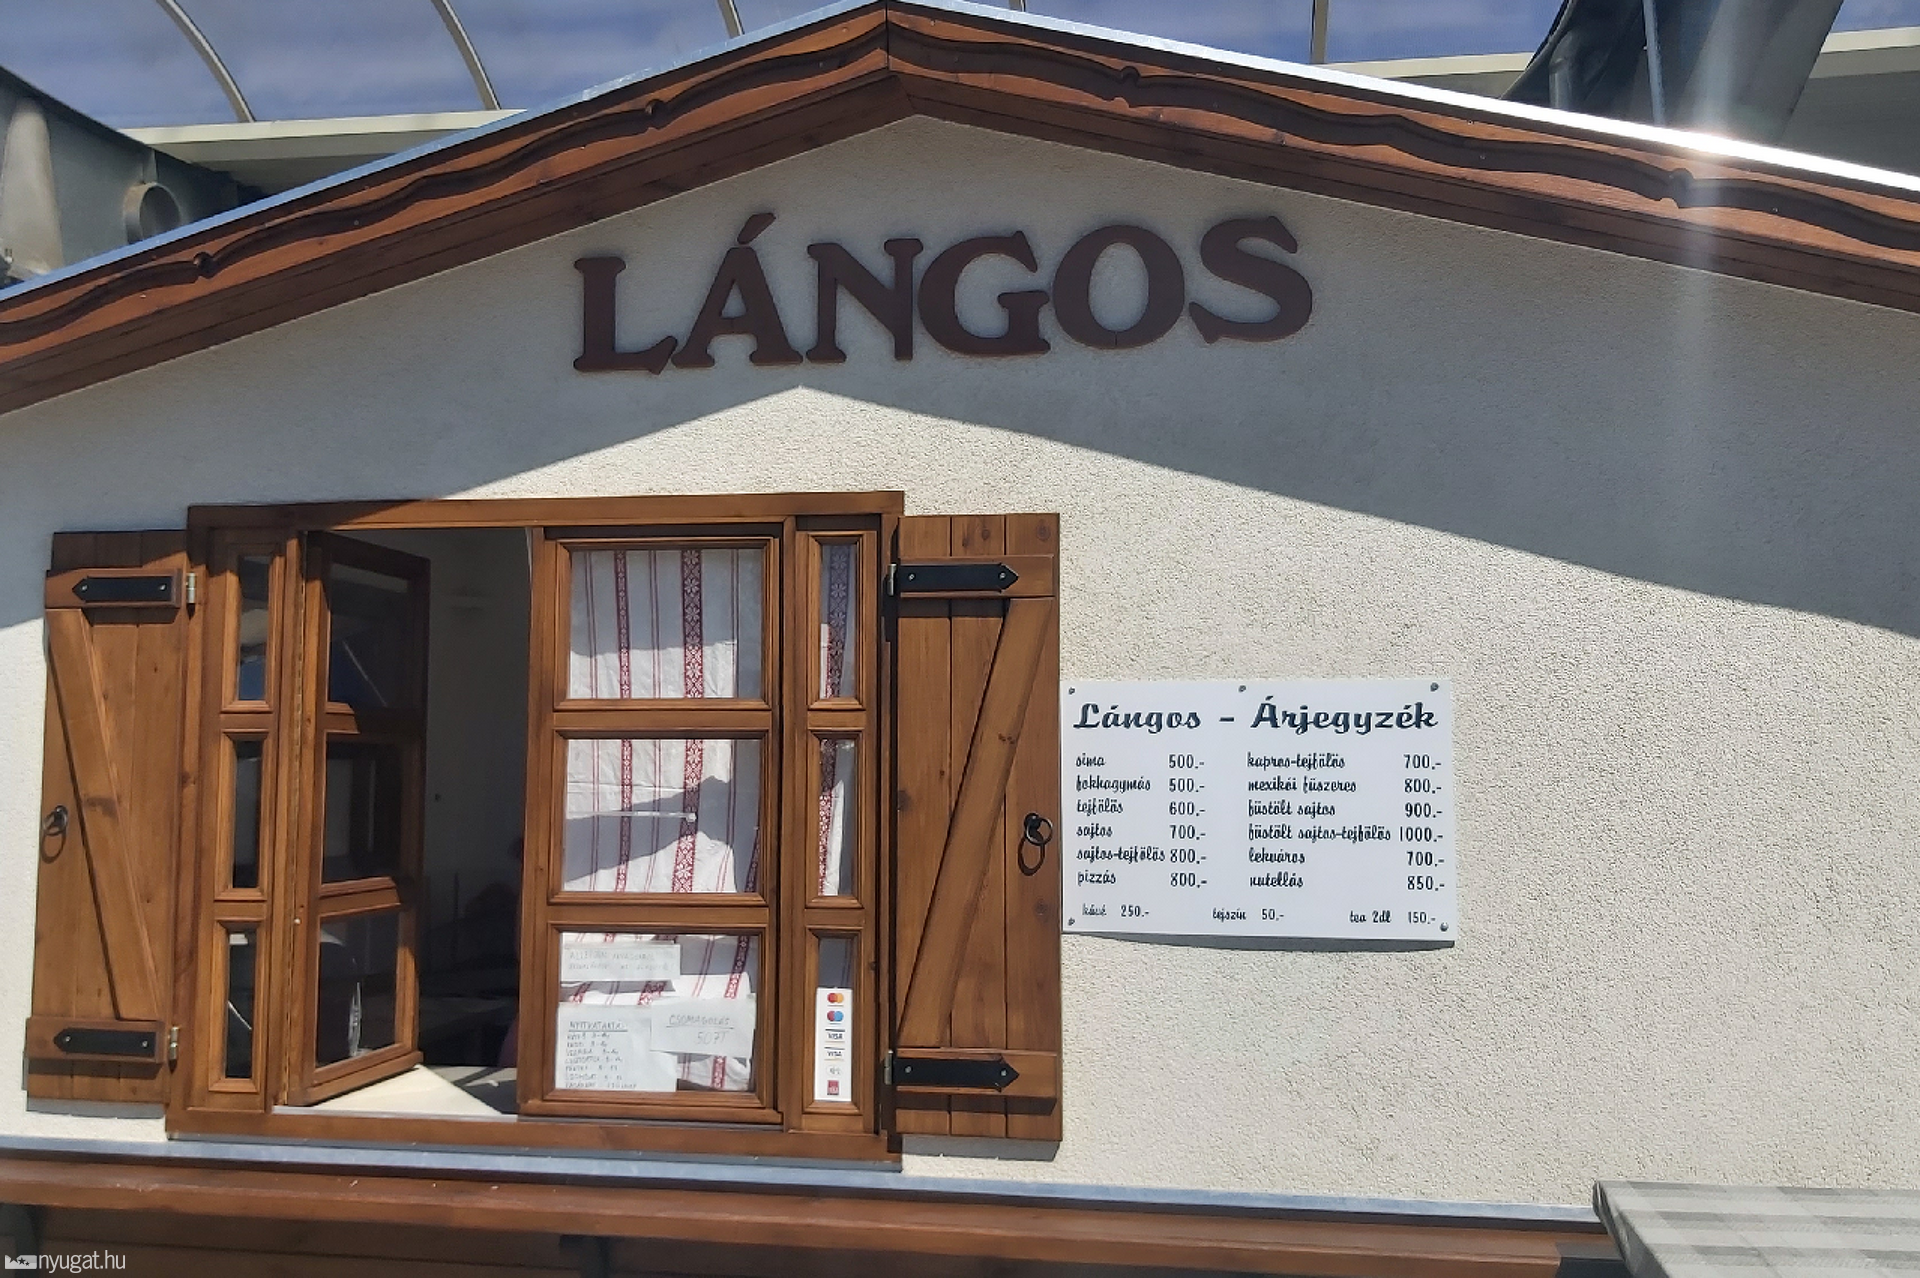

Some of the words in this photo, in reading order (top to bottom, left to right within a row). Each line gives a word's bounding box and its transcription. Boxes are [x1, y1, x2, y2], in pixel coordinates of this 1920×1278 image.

[572, 212, 1313, 375] LÁNGOS
[1073, 703, 1201, 734] Lángos
[1250, 695, 1438, 735] Árjegyzék
[1076, 753, 1106, 767] sima
[1169, 754, 1206, 770] 500.-
[1247, 751, 1345, 771] kapros-tejfölös
[1403, 754, 1441, 770] 700.-
[1076, 775, 1150, 794] fokhagymás
[1169, 778, 1206, 793] 500.-
[1248, 775, 1297, 791] mexikói
[1405, 778, 1442, 794] 800.-
[1076, 798, 1123, 817] tejfölös
[1169, 801, 1206, 817] 600.-
[1249, 799, 1293, 818] füstölt
[1297, 801, 1335, 819] sajtos
[1405, 802, 1443, 818] 900.-
[1076, 823, 1113, 840] sajtos
[1169, 825, 1206, 840] 700.-
[1249, 823, 1293, 842] füstölt
[1298, 825, 1391, 844] sajtos-tejfölös
[1400, 826, 1443, 842] 1000.-
[1076, 846, 1165, 864] sajtos-tejfölös
[1170, 849, 1207, 864] 800.-
[1249, 847, 1305, 864] lekváros
[1406, 850, 1444, 867] 700.-
[1078, 870, 1116, 887] pizzás
[1171, 872, 1207, 888] 800.-
[1250, 871, 1303, 888] nutellás
[1408, 876, 1445, 891] 850.-
[1121, 904, 1149, 917] 250.-
[1262, 909, 1284, 921] 50.-
[1350, 910, 1367, 923] tea
[1372, 910, 1392, 923] 2dl
[1408, 911, 1436, 924] 150.-
